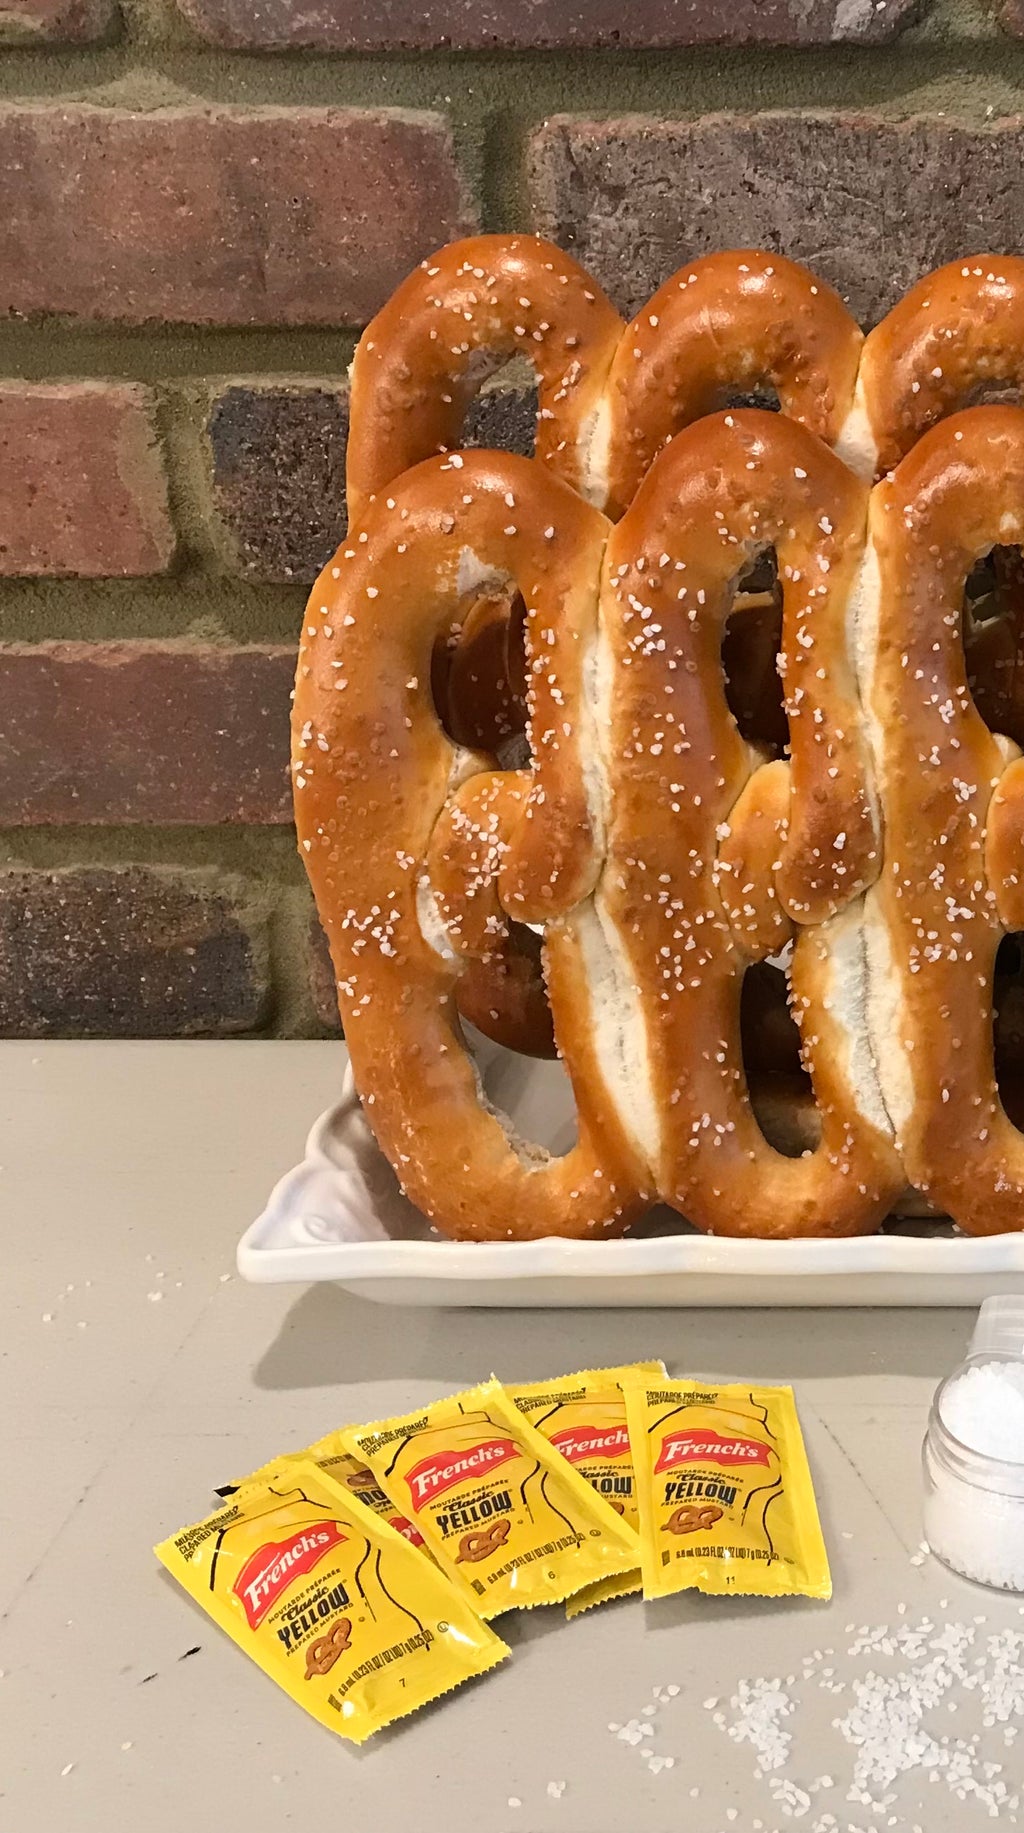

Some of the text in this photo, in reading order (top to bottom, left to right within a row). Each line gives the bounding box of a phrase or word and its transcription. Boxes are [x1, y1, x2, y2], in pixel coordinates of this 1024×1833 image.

[664, 1439, 758, 1462] French's
[412, 1446, 505, 1497] French's
[676, 1474, 725, 1484] Classic
[443, 1491, 494, 1511] Classic
[665, 1482, 737, 1504] YELLOW
[436, 1490, 512, 1535] YELLOW
[244, 1531, 329, 1612] French's
[548, 1571, 556, 1579] 6
[726, 1576, 735, 1584] 11
[281, 1586, 329, 1621] Classic
[277, 1583, 350, 1649] YELLOW
[399, 1678, 406, 1687] 7
